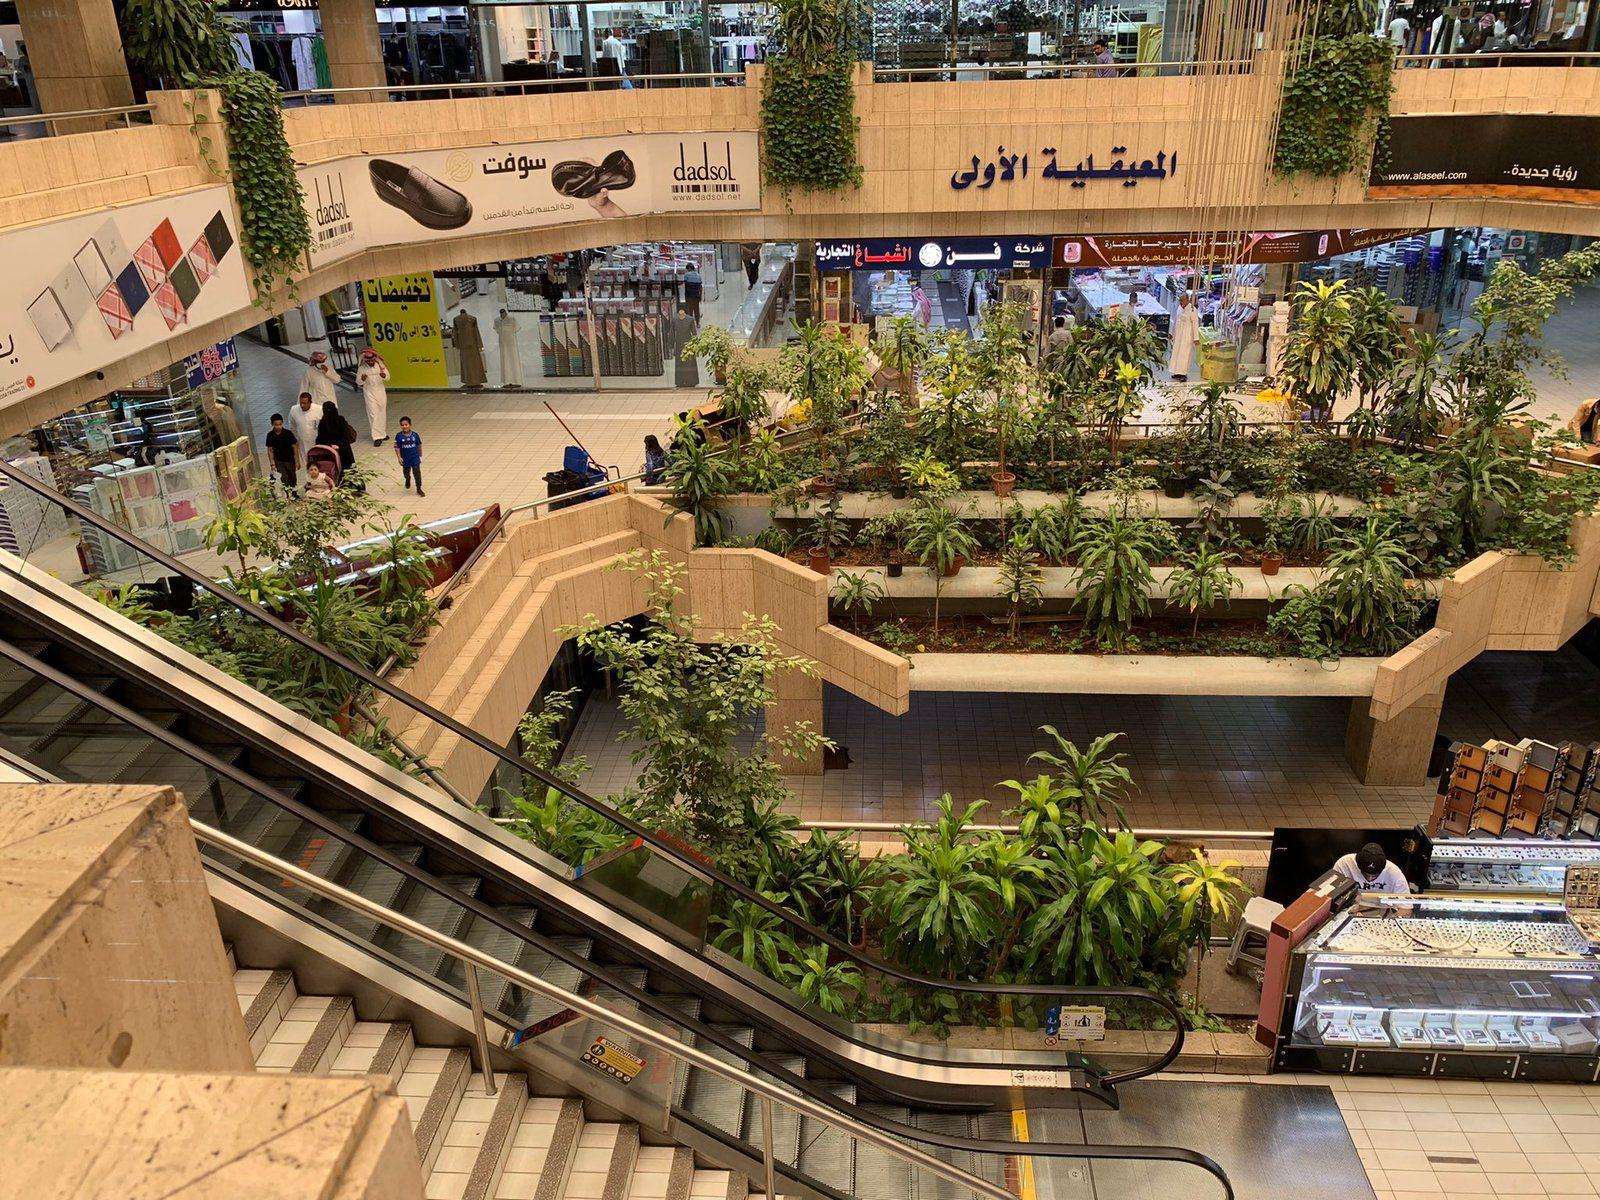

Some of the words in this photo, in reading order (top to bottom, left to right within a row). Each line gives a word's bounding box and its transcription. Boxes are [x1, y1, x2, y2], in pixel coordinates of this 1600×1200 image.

[482, 152, 547, 180] سوفت
[673, 141, 736, 181] dadsol
[950, 145, 1028, 190] الأولى
[1042, 145, 1178, 188] المعيقلية
[1388, 171, 1468, 181] www.alaseel.com
[1552, 165, 1578, 182] رؤية
[316, 172, 350, 226] dadsol
[672, 193, 742, 201] www.dadsol.net
[815, 241, 855, 261] التجارية
[854, 243, 913, 267] الشماغ
[1014, 242, 1045, 254] شركة
[367, 277, 431, 311] تخفيضات
[373, 321, 408, 342] 36%
